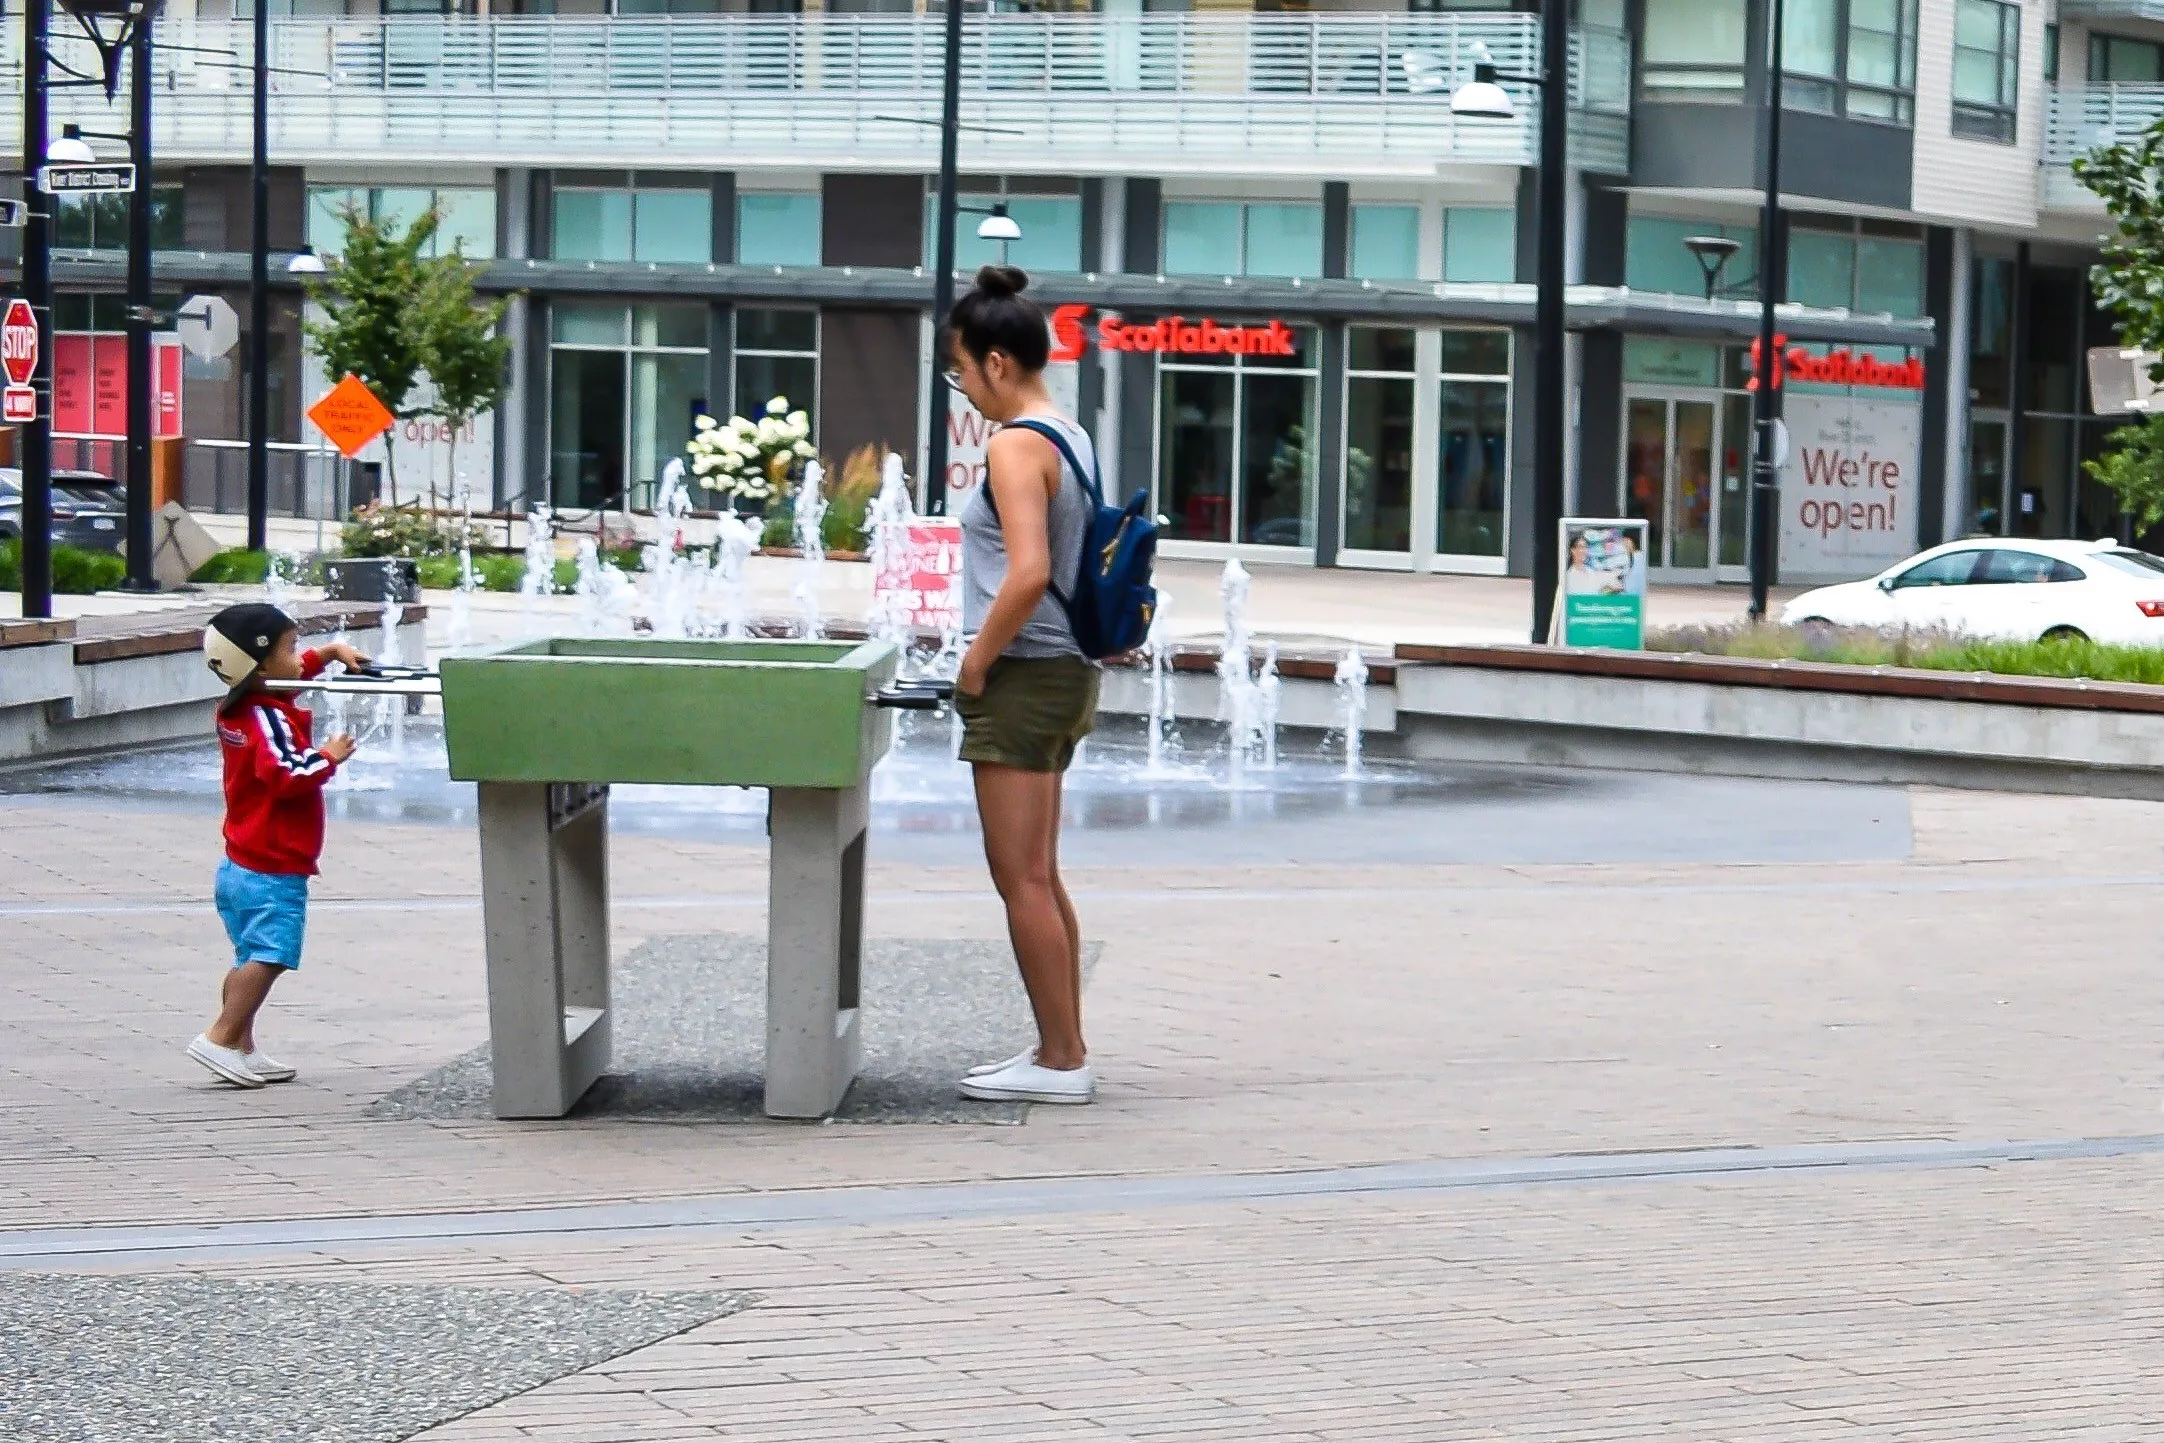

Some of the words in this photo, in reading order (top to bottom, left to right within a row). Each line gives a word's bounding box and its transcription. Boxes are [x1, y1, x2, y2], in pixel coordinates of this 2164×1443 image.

[3, 325, 36, 359] STOP
[1097, 315, 1294, 355] Scotiabank
[1801, 446, 1900, 489] We're
[1800, 494, 1896, 540] open!
